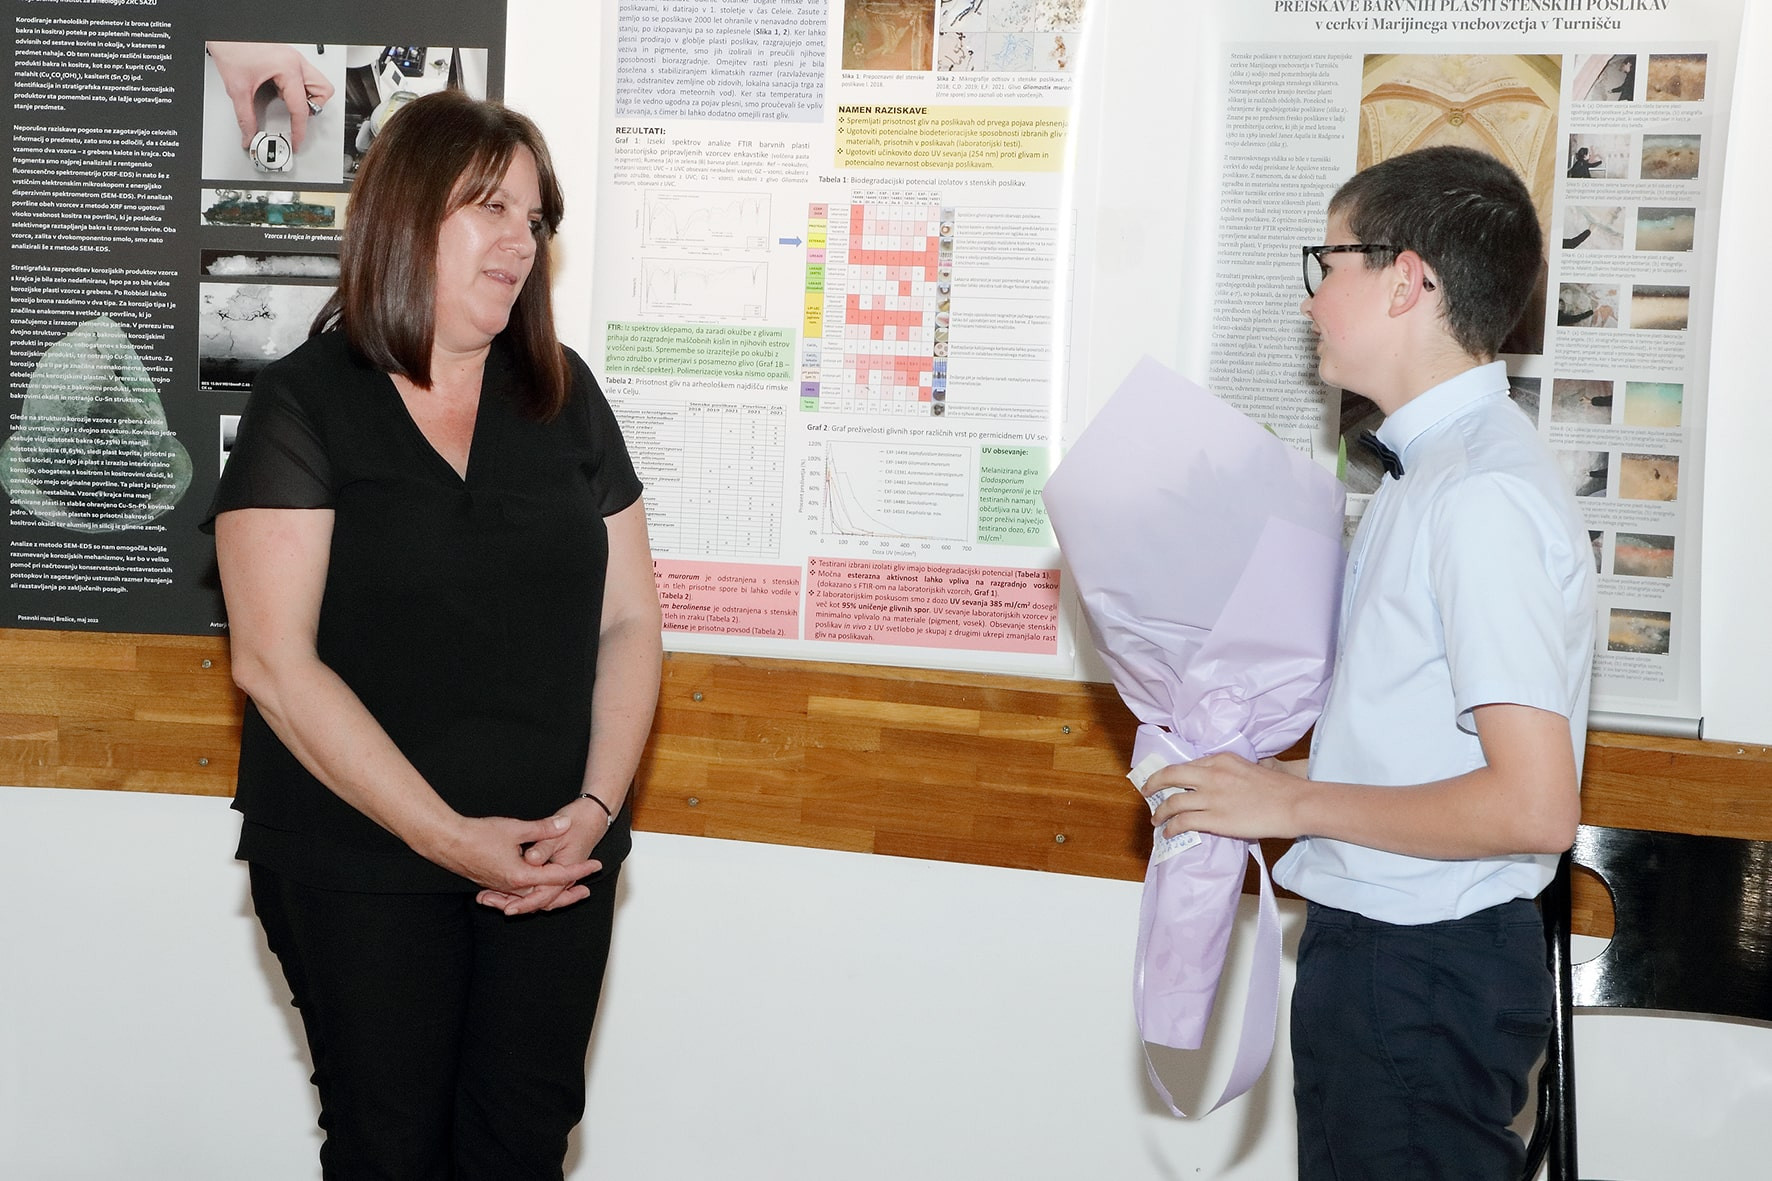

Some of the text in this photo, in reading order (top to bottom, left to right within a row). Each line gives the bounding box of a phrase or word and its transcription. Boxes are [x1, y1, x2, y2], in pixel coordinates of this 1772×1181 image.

[1275, 0, 1670, 12] PREISKAVE BARVNIH PLASTI STENSKIH POSLIKAV
[16, 16, 52, 25] Korodiranje
[89, 18, 123, 28] predmetov
[150, 20, 171, 29] (zlitine
[1316, 16, 1620, 32] v cerkvi Marijinega vnebovzetja v Turnišču
[616, 106, 625, 115] UV
[626, 107, 652, 118] sevanja,
[659, 108, 677, 116] čimer
[679, 108, 686, 116] bi
[688, 108, 706, 117] lahko
[707, 109, 736, 117] dodatno
[737, 109, 760, 120] omejili
[762, 110, 774, 118] rast
[838, 105, 926, 114] NAMEN RAZISKAVE
[13, 124, 47, 133] Neporušne
[77, 125, 103, 135] pogosto
[113, 126, 150, 136] zagotavljajo
[616, 126, 665, 134] REZULTATI:
[846, 147, 1049, 160] Ugotoviti učinkovito dozo UV sevanja (254 nm) proti glivam in
[819, 175, 841, 183] Tabela
[851, 175, 904, 186] Biodegradacijski
[906, 176, 936, 187] potencial
[938, 177, 963, 185] izolatov
[970, 177, 996, 186] stenskih
[12, 188, 51, 198] disperzivnim
[52, 190, 100, 200] spektrometrom
[100, 191, 136, 201] (SEM-EDS).
[11, 264, 50, 273] Stratigrafska
[52, 265, 90, 274] razporeditev
[91, 266, 124, 275] korozijskih
[125, 267, 157, 276] produktov
[608, 323, 623, 331] FTIR:
[625, 323, 629, 332] Iz
[632, 324, 659, 335] spektrov
[660, 325, 693, 336] sklepamo,
[696, 326, 704, 334] da
[706, 326, 726, 335] zaradi
[727, 327, 751, 336] okužbe
[758, 328, 782, 339] glivami
[606, 376, 626, 384] Tabela
[636, 377, 668, 386] Prisotnost
[669, 378, 680, 389] gliv
[692, 379, 735, 389] arheološkem
[736, 381, 764, 392] najdišču
[766, 382, 788, 391] rimske
[807, 422, 822, 431] Graf
[832, 424, 846, 432] Graf
[847, 424, 885, 436] preživelosti
[886, 426, 908, 437] glivnih
[910, 429, 924, 438] spor
[926, 427, 953, 436] različnih
[954, 428, 966, 437] vrst
[968, 432, 977, 440] po
[978, 430, 1023, 442] germicidnem
[1025, 431, 1035, 440] UV
[982, 445, 1028, 457] UV obsevanje:
[981, 465, 1038, 477] Melanizirana gliva
[981, 475, 1024, 487] Cladosporium
[978, 523, 1040, 535] testirano dozo, 670
[116, 543, 148, 553] omogočile
[149, 544, 167, 553] boljše
[819, 558, 846, 568] Testirani
[848, 560, 870, 569] izbrani
[872, 561, 892, 570] izolati
[893, 562, 905, 573] gliv
[906, 563, 925, 574] imajo
[927, 564, 980, 577] biodegradacijski
[982, 566, 1013, 578] potencial
[1014, 568, 1040, 580] (Tabela
[816, 599, 827, 608] več
[829, 600, 840, 608] kot
[842, 601, 856, 609] 95%
[858, 601, 887, 613] uničenje
[889, 603, 912, 614] glivnih
[934, 605, 943, 614] UV
[945, 606, 970, 617] sevanje
[972, 607, 1020, 620] laboratorijskih
[1050, 612, 1058, 622] je
[663, 621, 688, 630] kiliense
[690, 622, 696, 633] je
[698, 623, 725, 634] prisotna
[726, 624, 750, 636] povsod
[752, 626, 775, 637] (Tabela
